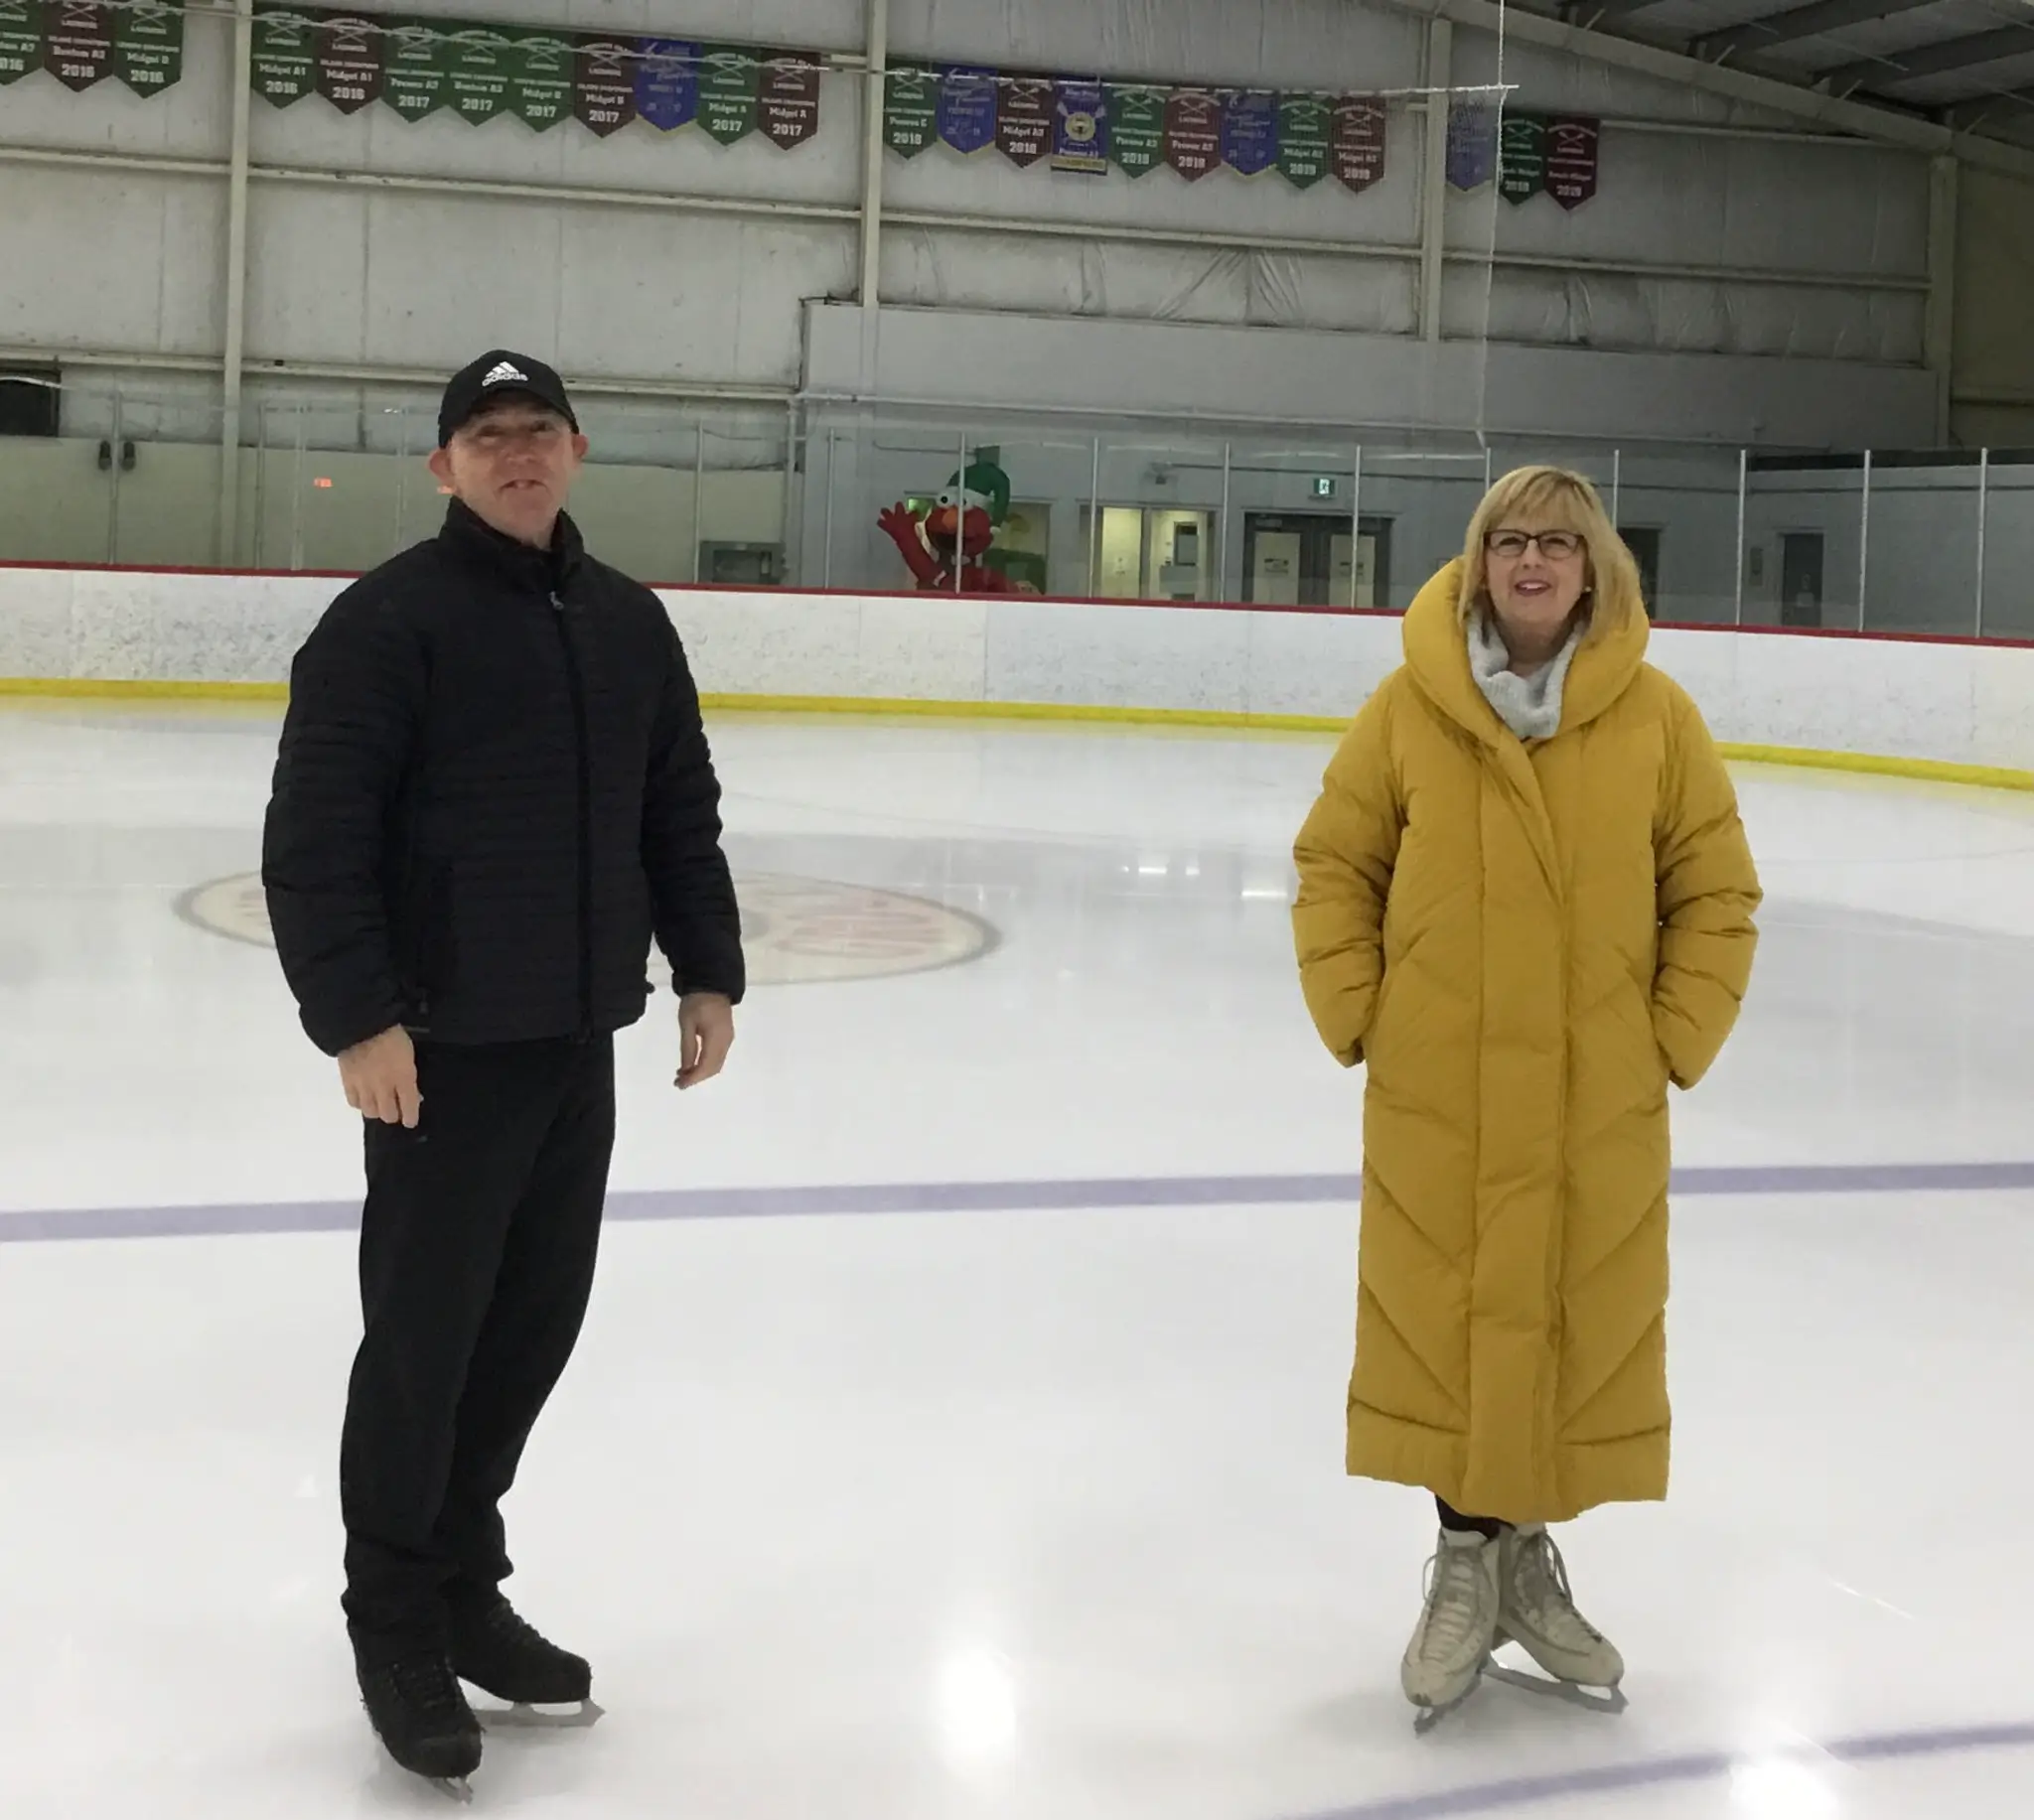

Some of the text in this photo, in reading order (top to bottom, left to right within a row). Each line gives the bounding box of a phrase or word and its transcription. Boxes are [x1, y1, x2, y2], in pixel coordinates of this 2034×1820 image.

[259, 64, 291, 75] Midget
[326, 70, 358, 81] Midget
[398, 94, 429, 108] 2017
[462, 97, 493, 111] 2017
[525, 104, 557, 118] 2017
[709, 102, 737, 114] Midget
[770, 106, 798, 119] Midget
[589, 109, 620, 123] 2017
[712, 118, 743, 132] 2017
[773, 123, 802, 136] 2017
[1002, 126, 1031, 138] Midget
[482, 373, 528, 387] adidas
